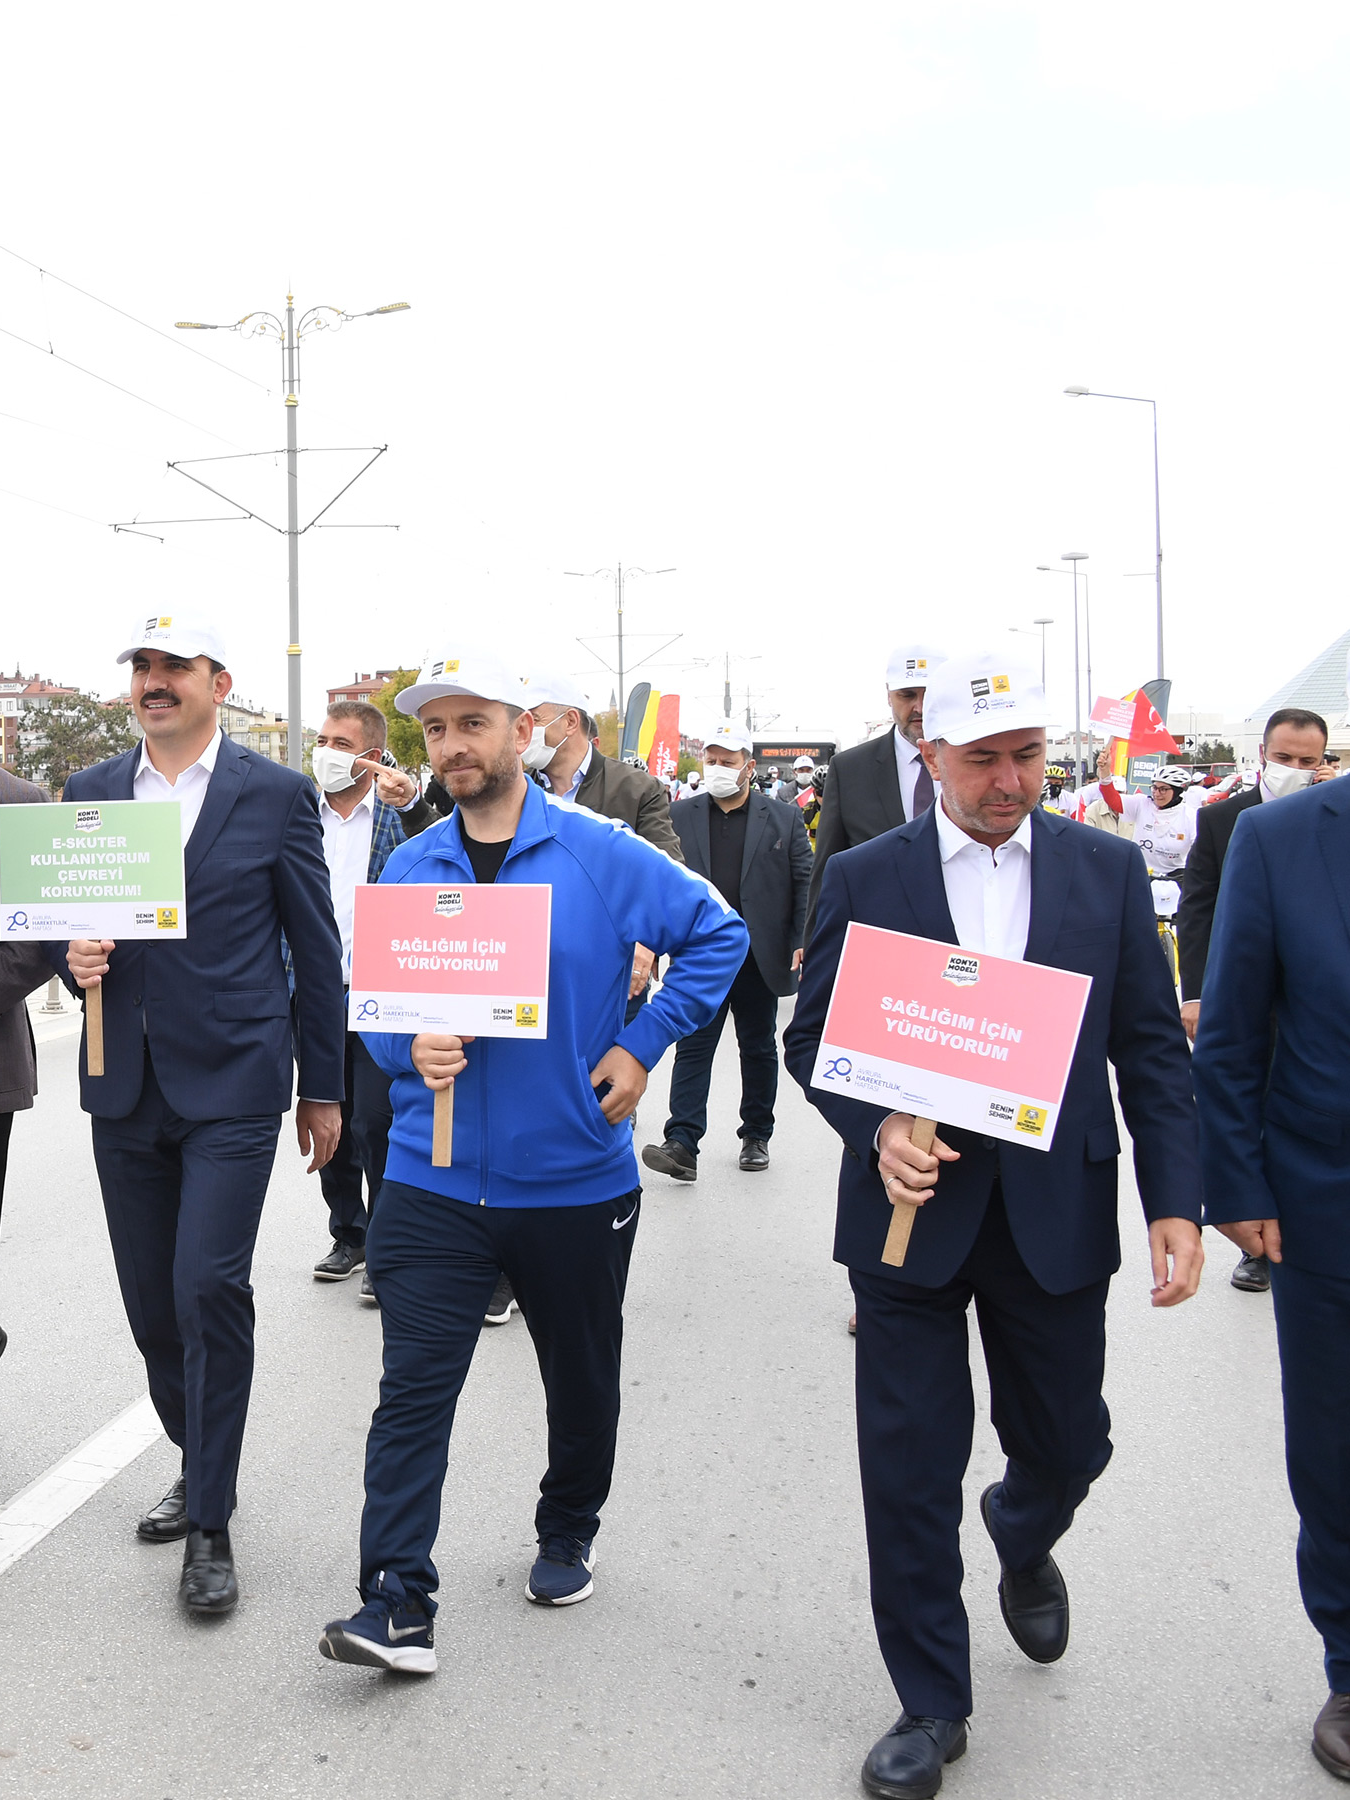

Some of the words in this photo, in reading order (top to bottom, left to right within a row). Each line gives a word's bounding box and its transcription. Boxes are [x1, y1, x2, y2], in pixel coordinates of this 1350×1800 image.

[52, 836, 127, 849] E-SKUTER
[30, 852, 150, 866] KULLANIYORUM
[58, 867, 123, 884] ÇEVREYİ
[41, 885, 142, 898] KORUYORUM!
[7, 911, 27, 931] 20
[390, 937, 467, 953] SAĞLIĞIM
[472, 938, 506, 956] İÇİN
[396, 956, 499, 972] YÜRÜYORUM
[948, 964, 977, 974] MODELİ
[950, 957, 978, 967] KONYA
[357, 999, 379, 1021] 20
[880, 995, 975, 1032] SAĞLIĞIM
[980, 1017, 1023, 1043] İÇİN
[885, 1017, 1009, 1061] YÜRÜYORUM
[823, 1057, 852, 1081] 20
[857, 1068, 882, 1079] AVRUPA
[854, 1081, 879, 1092] HAFTASI
[856, 1074, 901, 1091] HAREKETLİLİK
[990, 1102, 1014, 1114] BENİM
